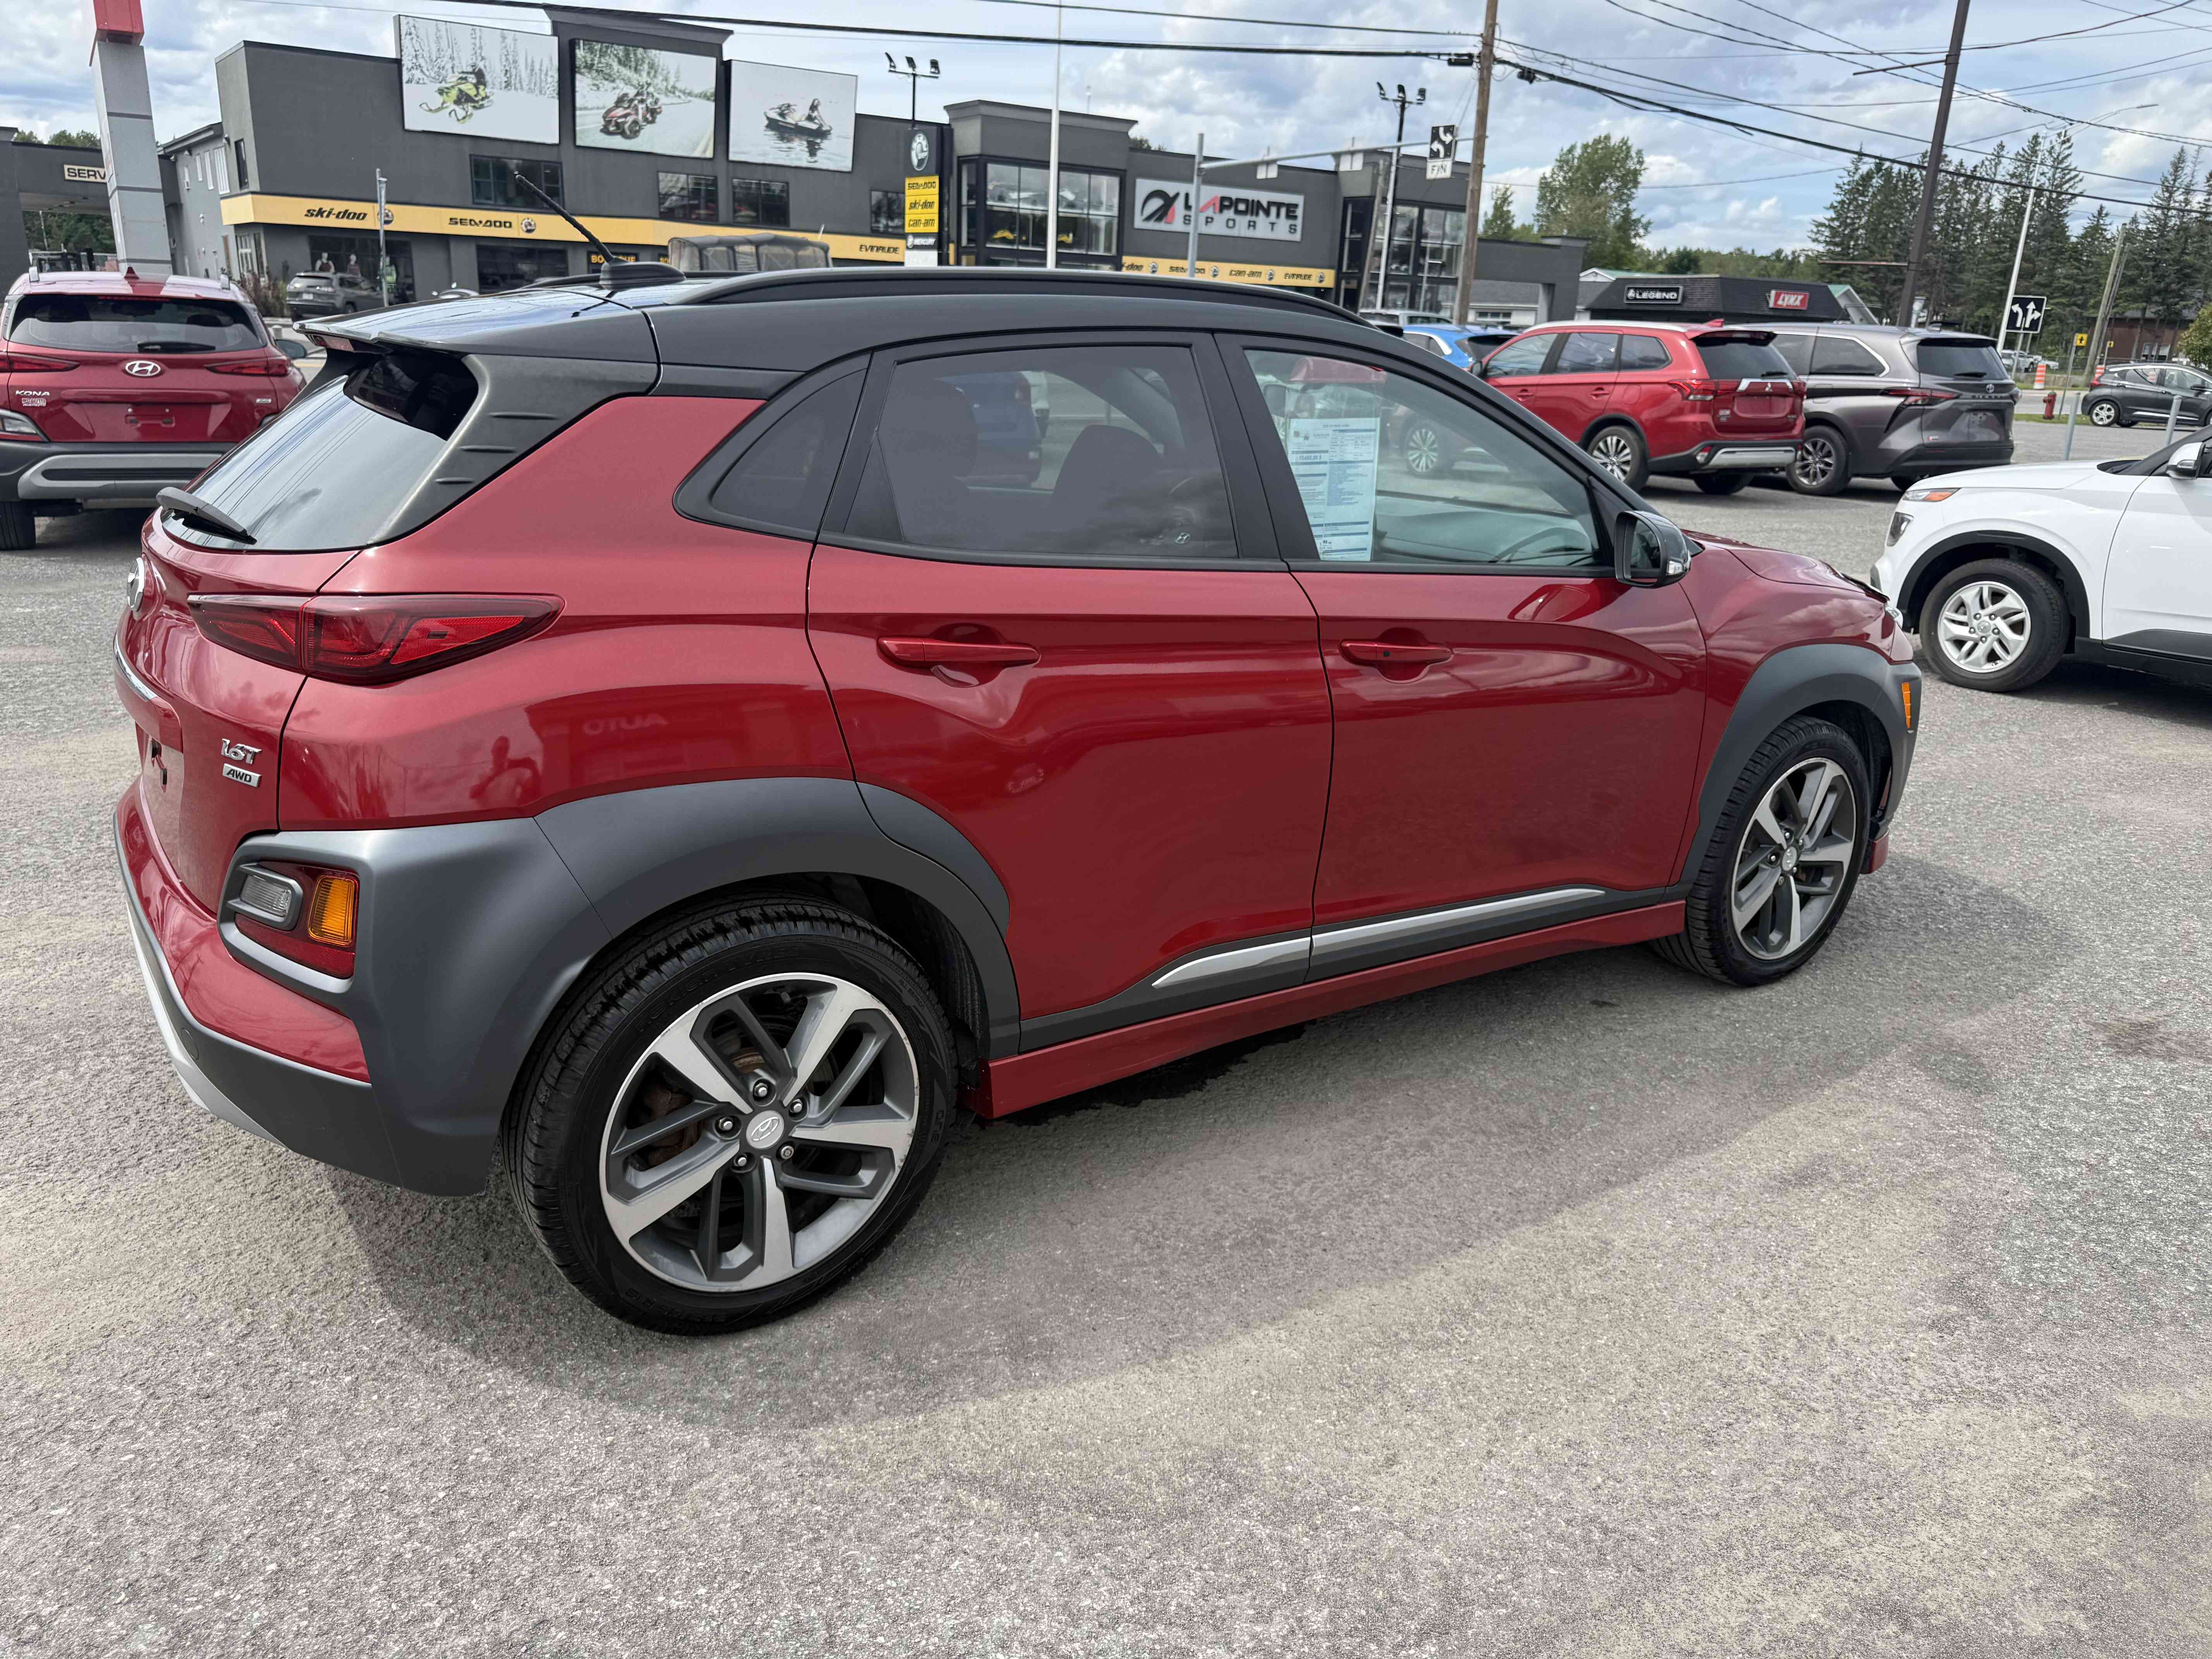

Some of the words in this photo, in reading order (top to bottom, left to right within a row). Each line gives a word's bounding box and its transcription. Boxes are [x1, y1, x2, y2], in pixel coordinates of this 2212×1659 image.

[67, 167, 106, 179] SERV
[1184, 192, 1299, 220] LAPOINTE
[304, 208, 368, 220] ski-doo
[1183, 215, 1298, 234] SPORTS
[859, 244, 900, 254] EVINRUDE
[1636, 290, 1678, 299] LEGEND
[227, 769, 252, 783] AWD
